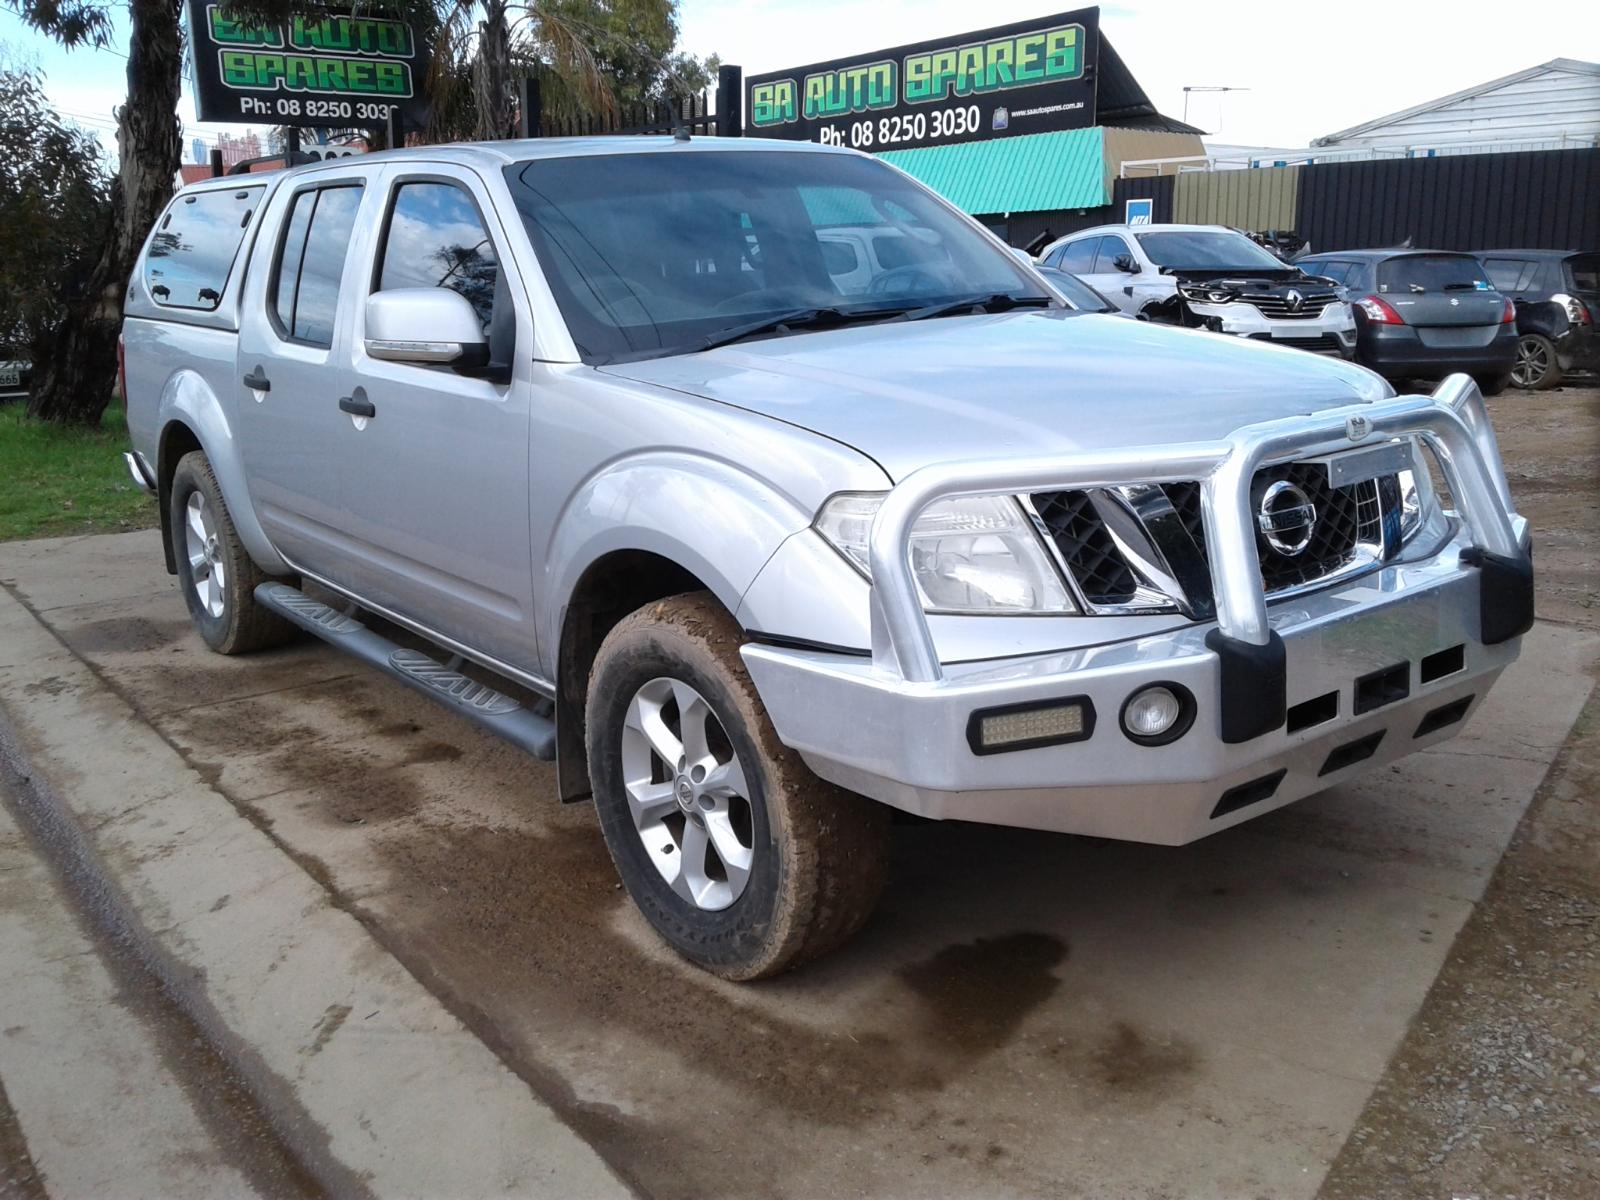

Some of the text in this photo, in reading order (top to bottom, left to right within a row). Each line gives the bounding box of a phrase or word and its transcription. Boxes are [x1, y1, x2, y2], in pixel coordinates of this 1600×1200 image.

[293, 15, 407, 53] AUTO
[223, 52, 405, 93] SPARES
[754, 27, 1077, 122] SA AUTO SPARES
[240, 97, 399, 120] Ph: 08 8250 303
[820, 105, 981, 147] Ph: 08 8250 3030
[1011, 101, 1085, 118] www.saautospares.com.au
